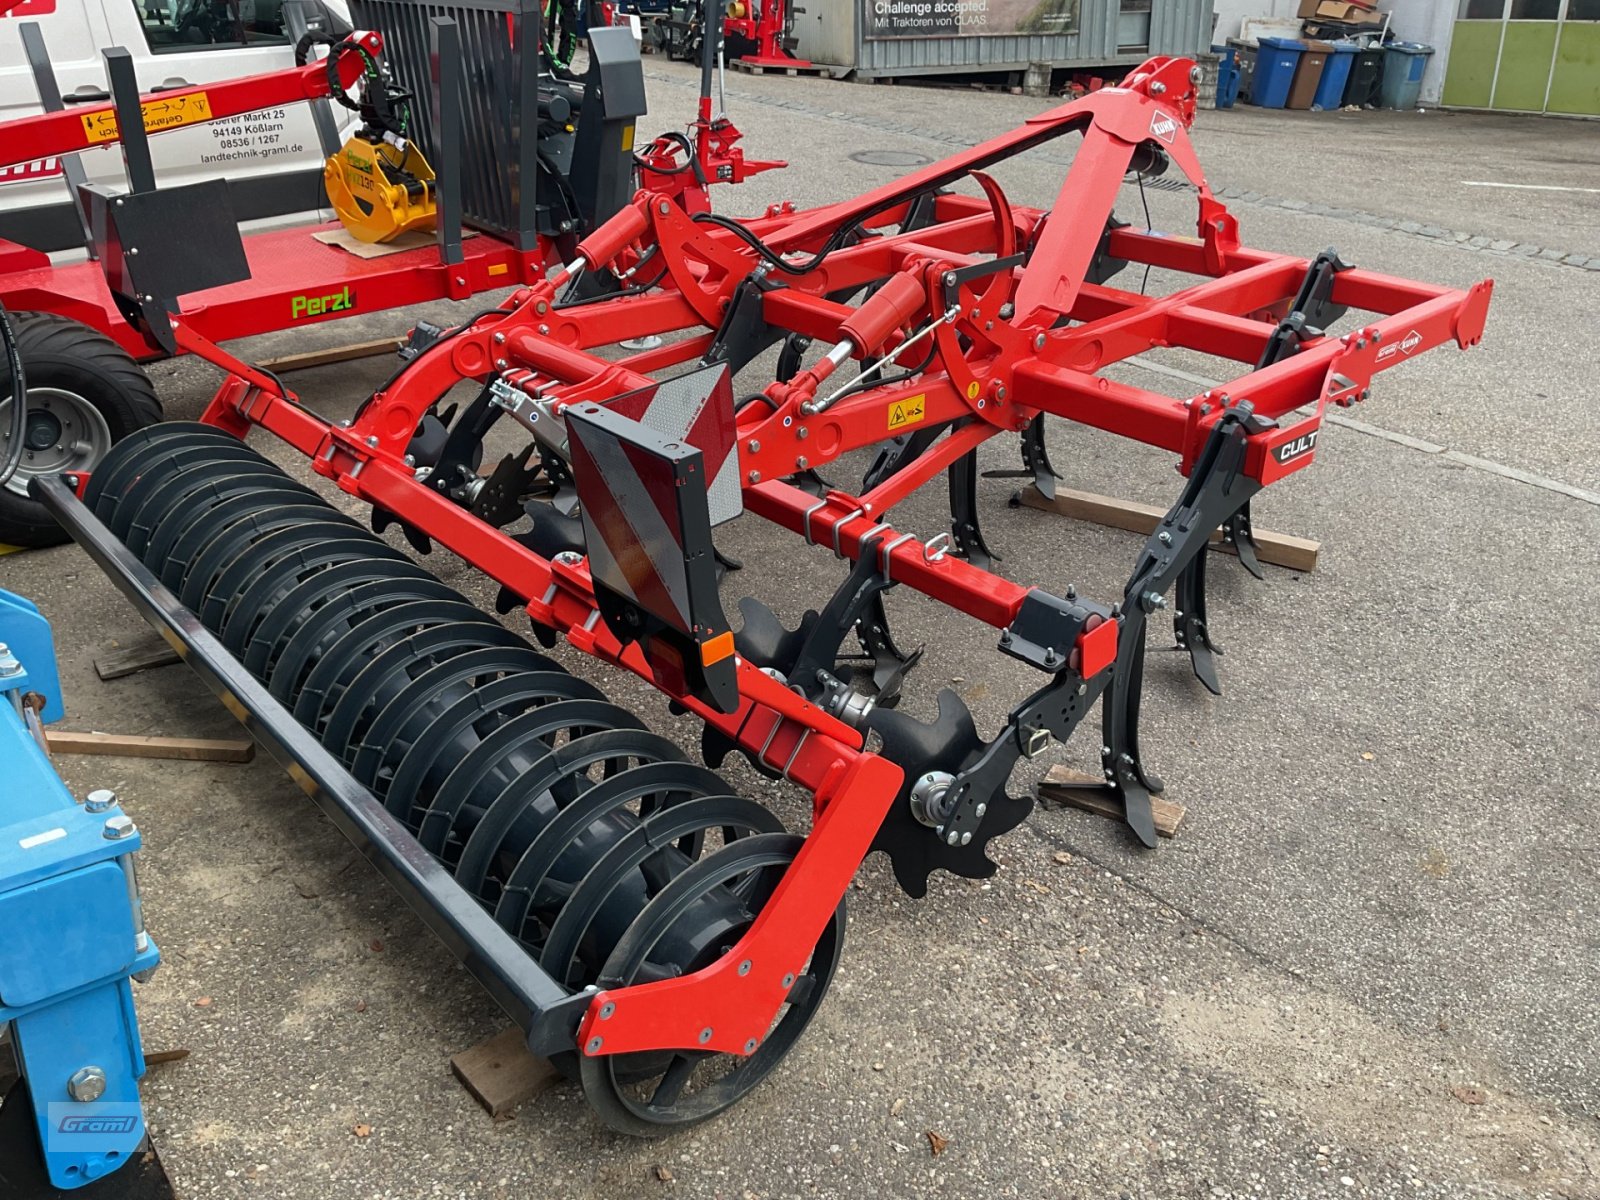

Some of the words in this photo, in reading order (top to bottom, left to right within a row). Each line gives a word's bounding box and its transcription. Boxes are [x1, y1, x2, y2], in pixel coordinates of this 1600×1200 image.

[874, 1, 932, 16] Challenge
[934, 1, 990, 15] accepted.
[874, 17, 889, 28] Mit
[891, 17, 934, 27] Traktoren
[935, 17, 952, 26] von
[243, 111, 271, 122] Markt
[273, 109, 286, 119] 25
[212, 126, 243, 138] 94149
[244, 122, 284, 135] Kößlarn
[220, 138, 250, 149] 08536
[258, 134, 280, 145] 1267
[200, 144, 304, 164] landtechnik-graml.de
[291, 285, 352, 320] Perzl
[1280, 431, 1318, 460] CULT
